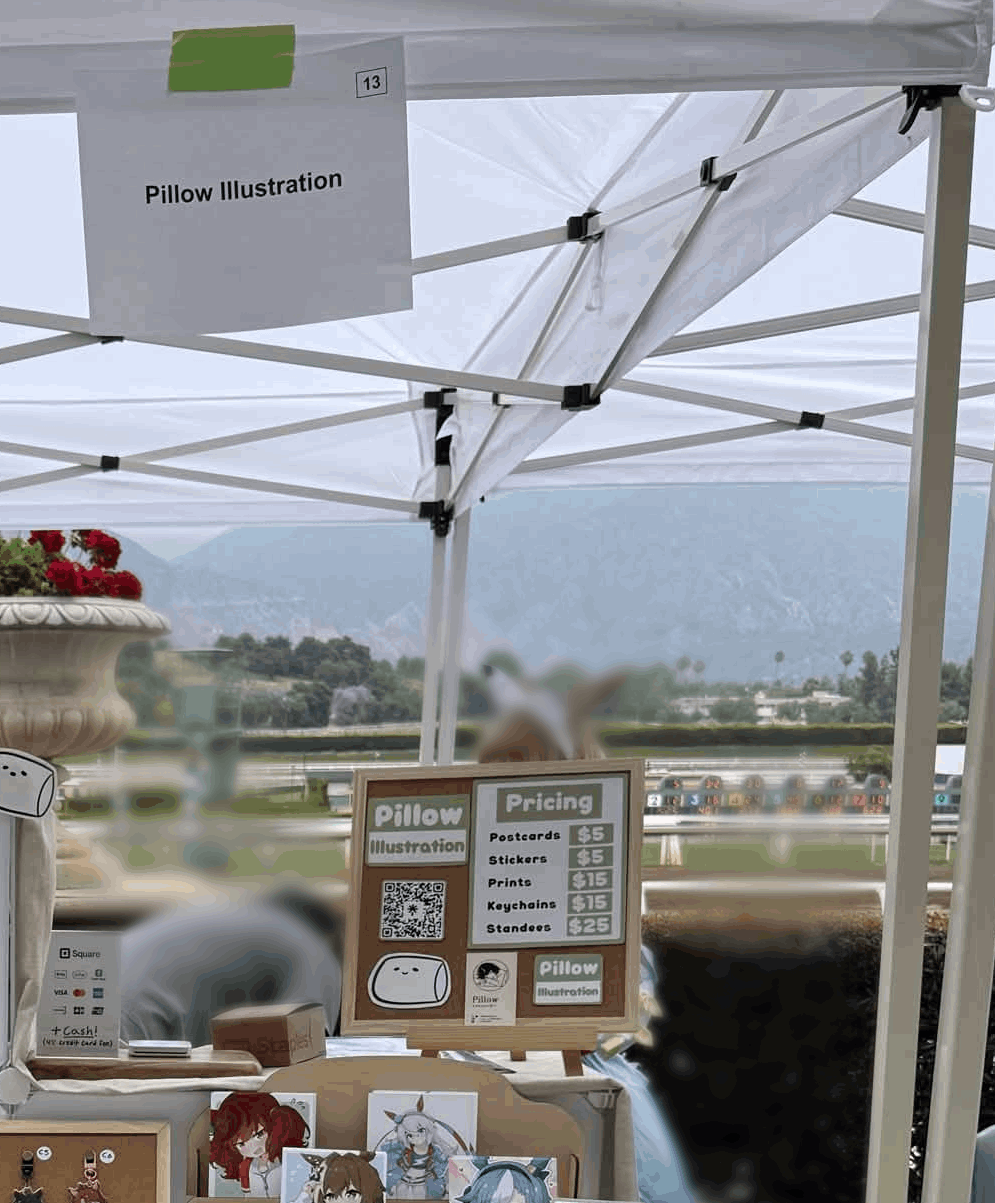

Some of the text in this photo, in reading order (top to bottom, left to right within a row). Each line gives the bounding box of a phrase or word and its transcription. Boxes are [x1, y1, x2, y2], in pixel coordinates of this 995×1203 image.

[362, 75, 381, 91] 13
[145, 171, 343, 204] Pillow Illustration
[506, 792, 593, 815] Pricing
[375, 804, 463, 827] Pillow
[489, 826, 605, 843] Postcards $5
[370, 838, 465, 854] Illustration
[488, 850, 605, 866] Stickers $5
[488, 872, 607, 889] Prints $15
[487, 895, 606, 913] Keychains $15
[487, 916, 610, 935] Standees $25
[72, 949, 101, 959] Square
[539, 961, 598, 976] Pillow
[537, 986, 599, 997] Illustration
